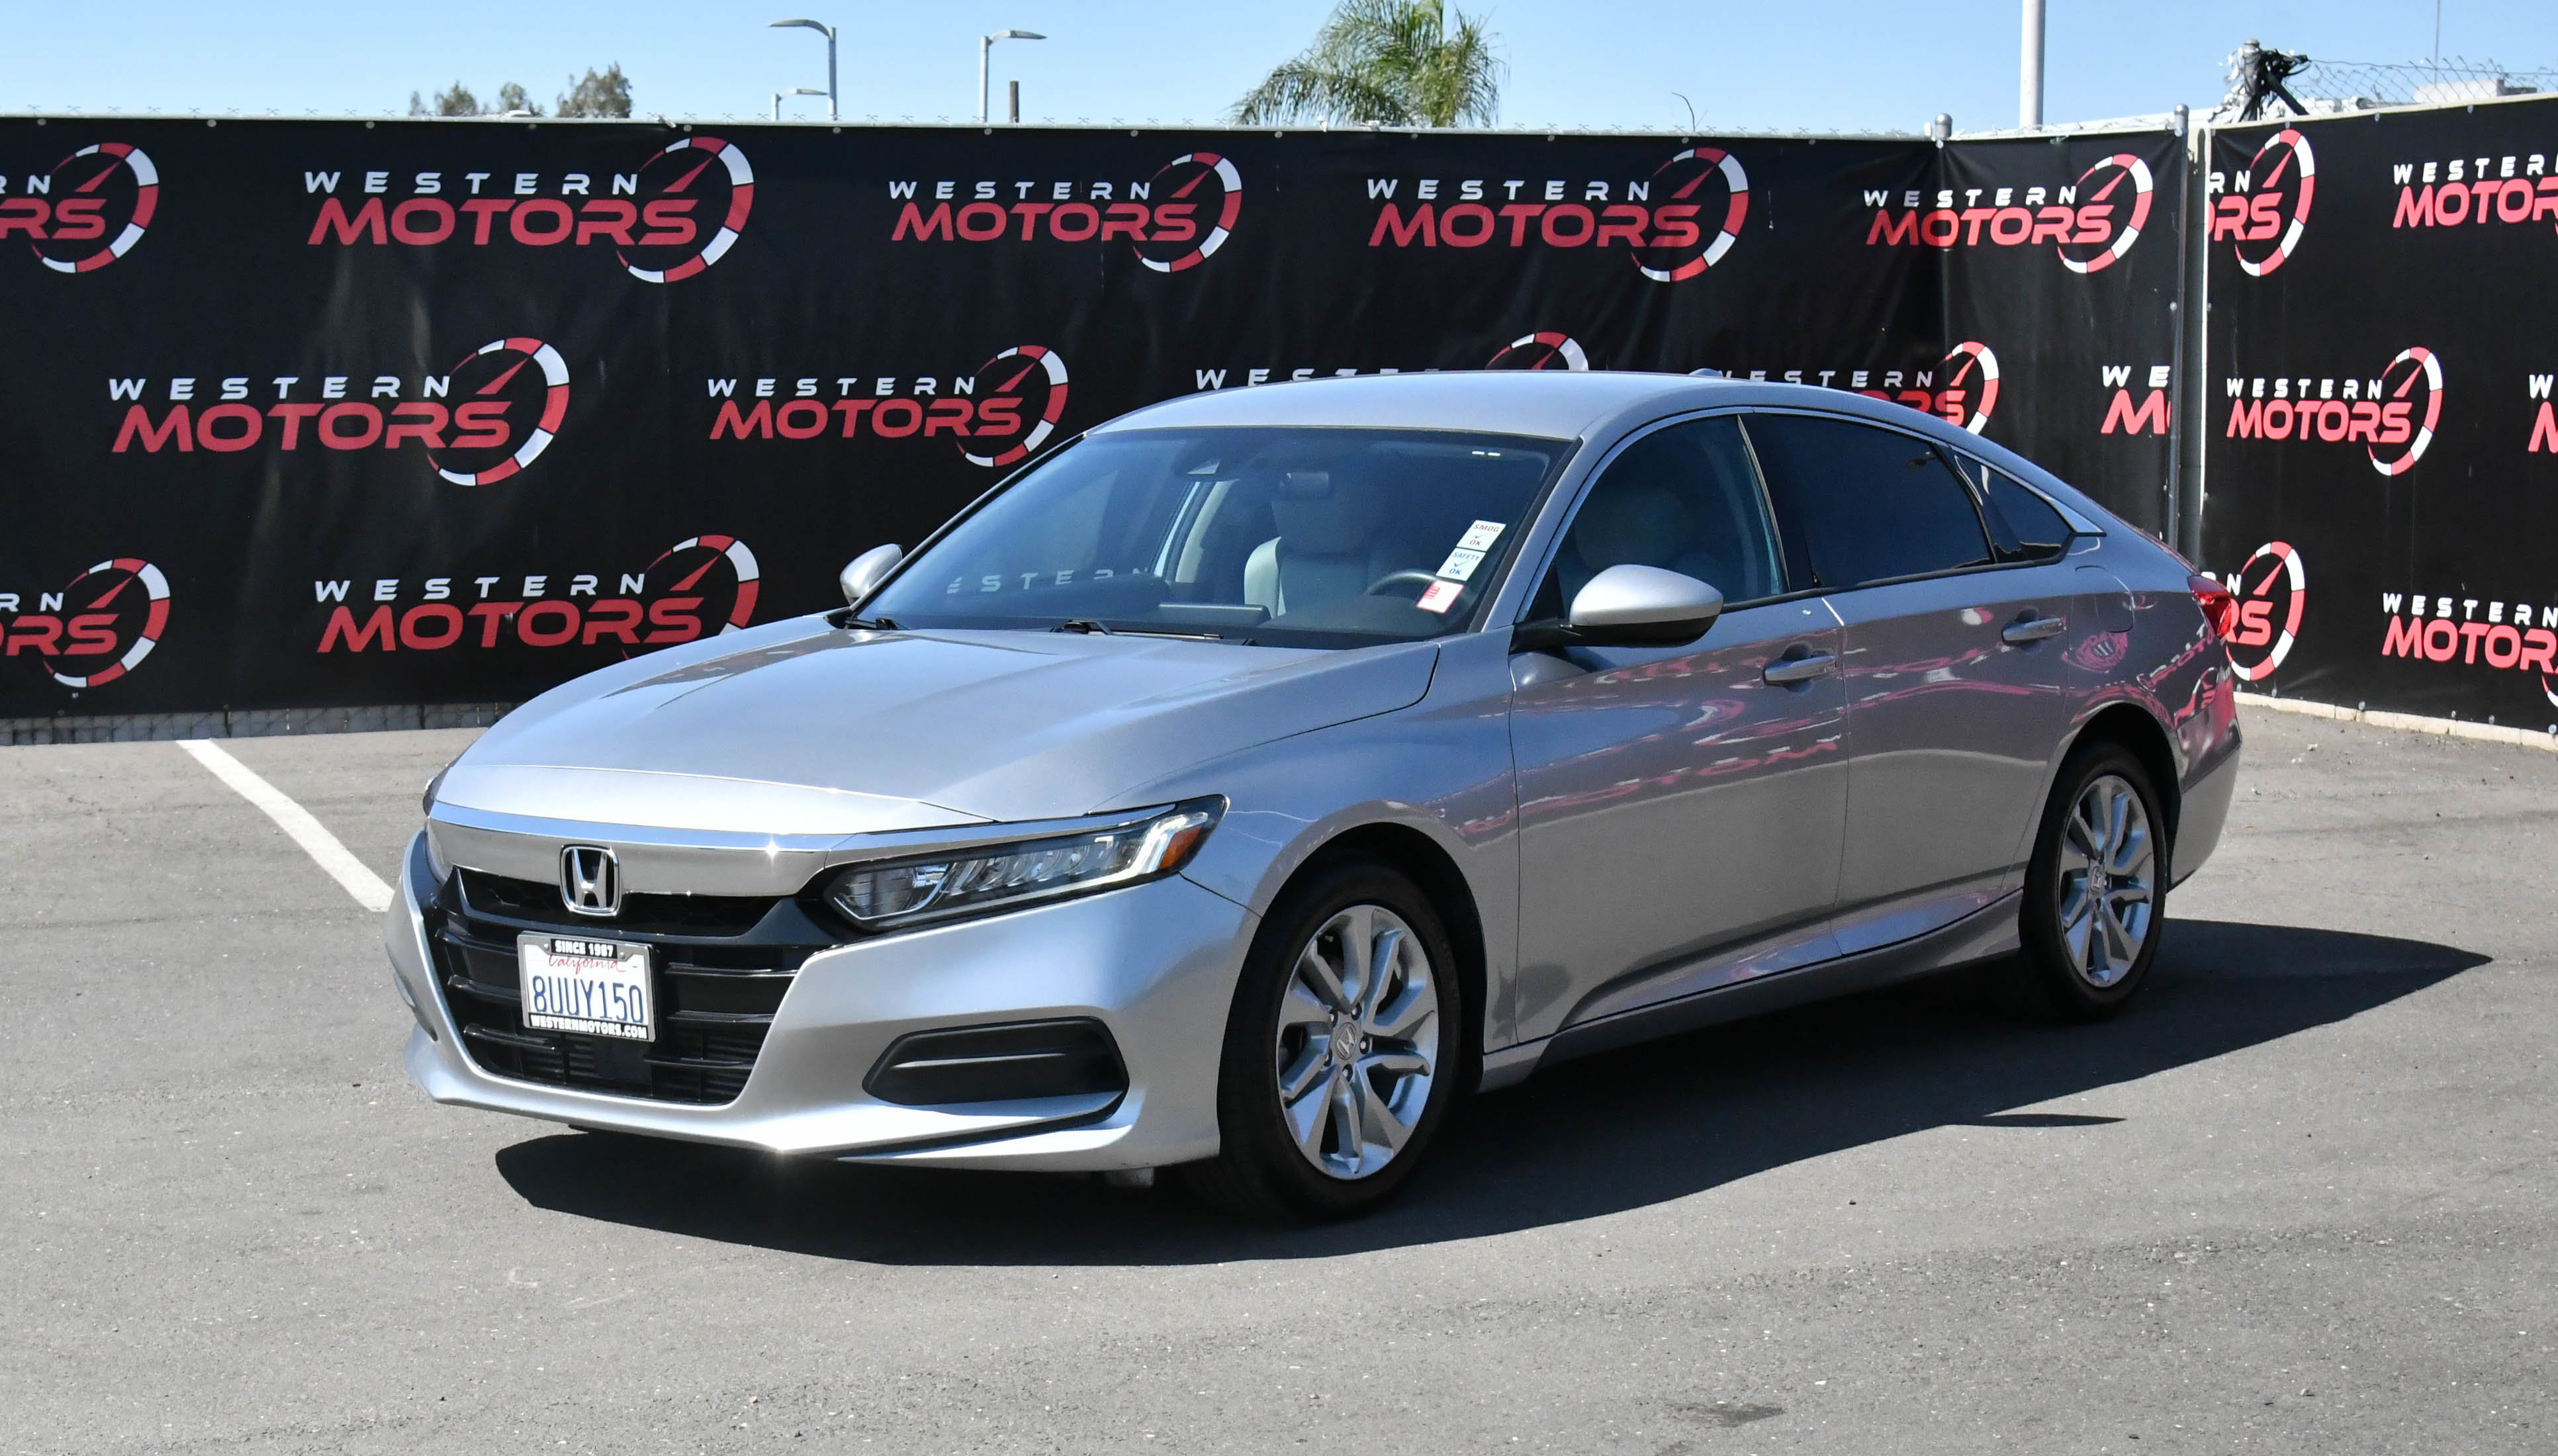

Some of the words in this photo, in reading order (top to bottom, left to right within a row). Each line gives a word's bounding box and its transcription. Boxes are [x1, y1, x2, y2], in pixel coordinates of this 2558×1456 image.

[305, 171, 637, 195] WESTERN
[2394, 154, 2558, 185] WESTER
[889, 181, 1151, 200] WESTERN
[1367, 179, 1649, 201] WESTERN
[1864, 185, 2077, 208] WESTERN
[308, 197, 699, 246] MOTORS
[891, 202, 1198, 242] MOTORS
[1369, 203, 1701, 248] MOTORS
[1866, 205, 2115, 246] MOTORS
[2208, 192, 2283, 242] RS
[109, 375, 450, 401] WESTERN
[708, 377, 975, 397] WESTERN
[2102, 365, 2171, 388] WE
[2226, 377, 2383, 400] WESTERN
[2529, 374, 2554, 399] W
[112, 400, 512, 453] MOTORS
[709, 397, 1023, 439] MOTORS
[2100, 388, 2171, 435] M
[2226, 400, 2413, 444] MOTORS
[1473, 523, 1500, 533] SMOG
[1452, 552, 1481, 561] SAFETY
[315, 573, 645, 602] WESTERN
[317, 597, 705, 653] MOTORS
[2383, 592, 2558, 629] WESTERN
[0, 614, 120, 656] RS
[2382, 615, 2558, 674] MOTOR
[555, 940, 586, 955] SINCE
[588, 942, 614, 958] 1987
[532, 975, 644, 1024] 8UUY150
[530, 1015, 648, 1039] WESTERNMOTORS.COM
